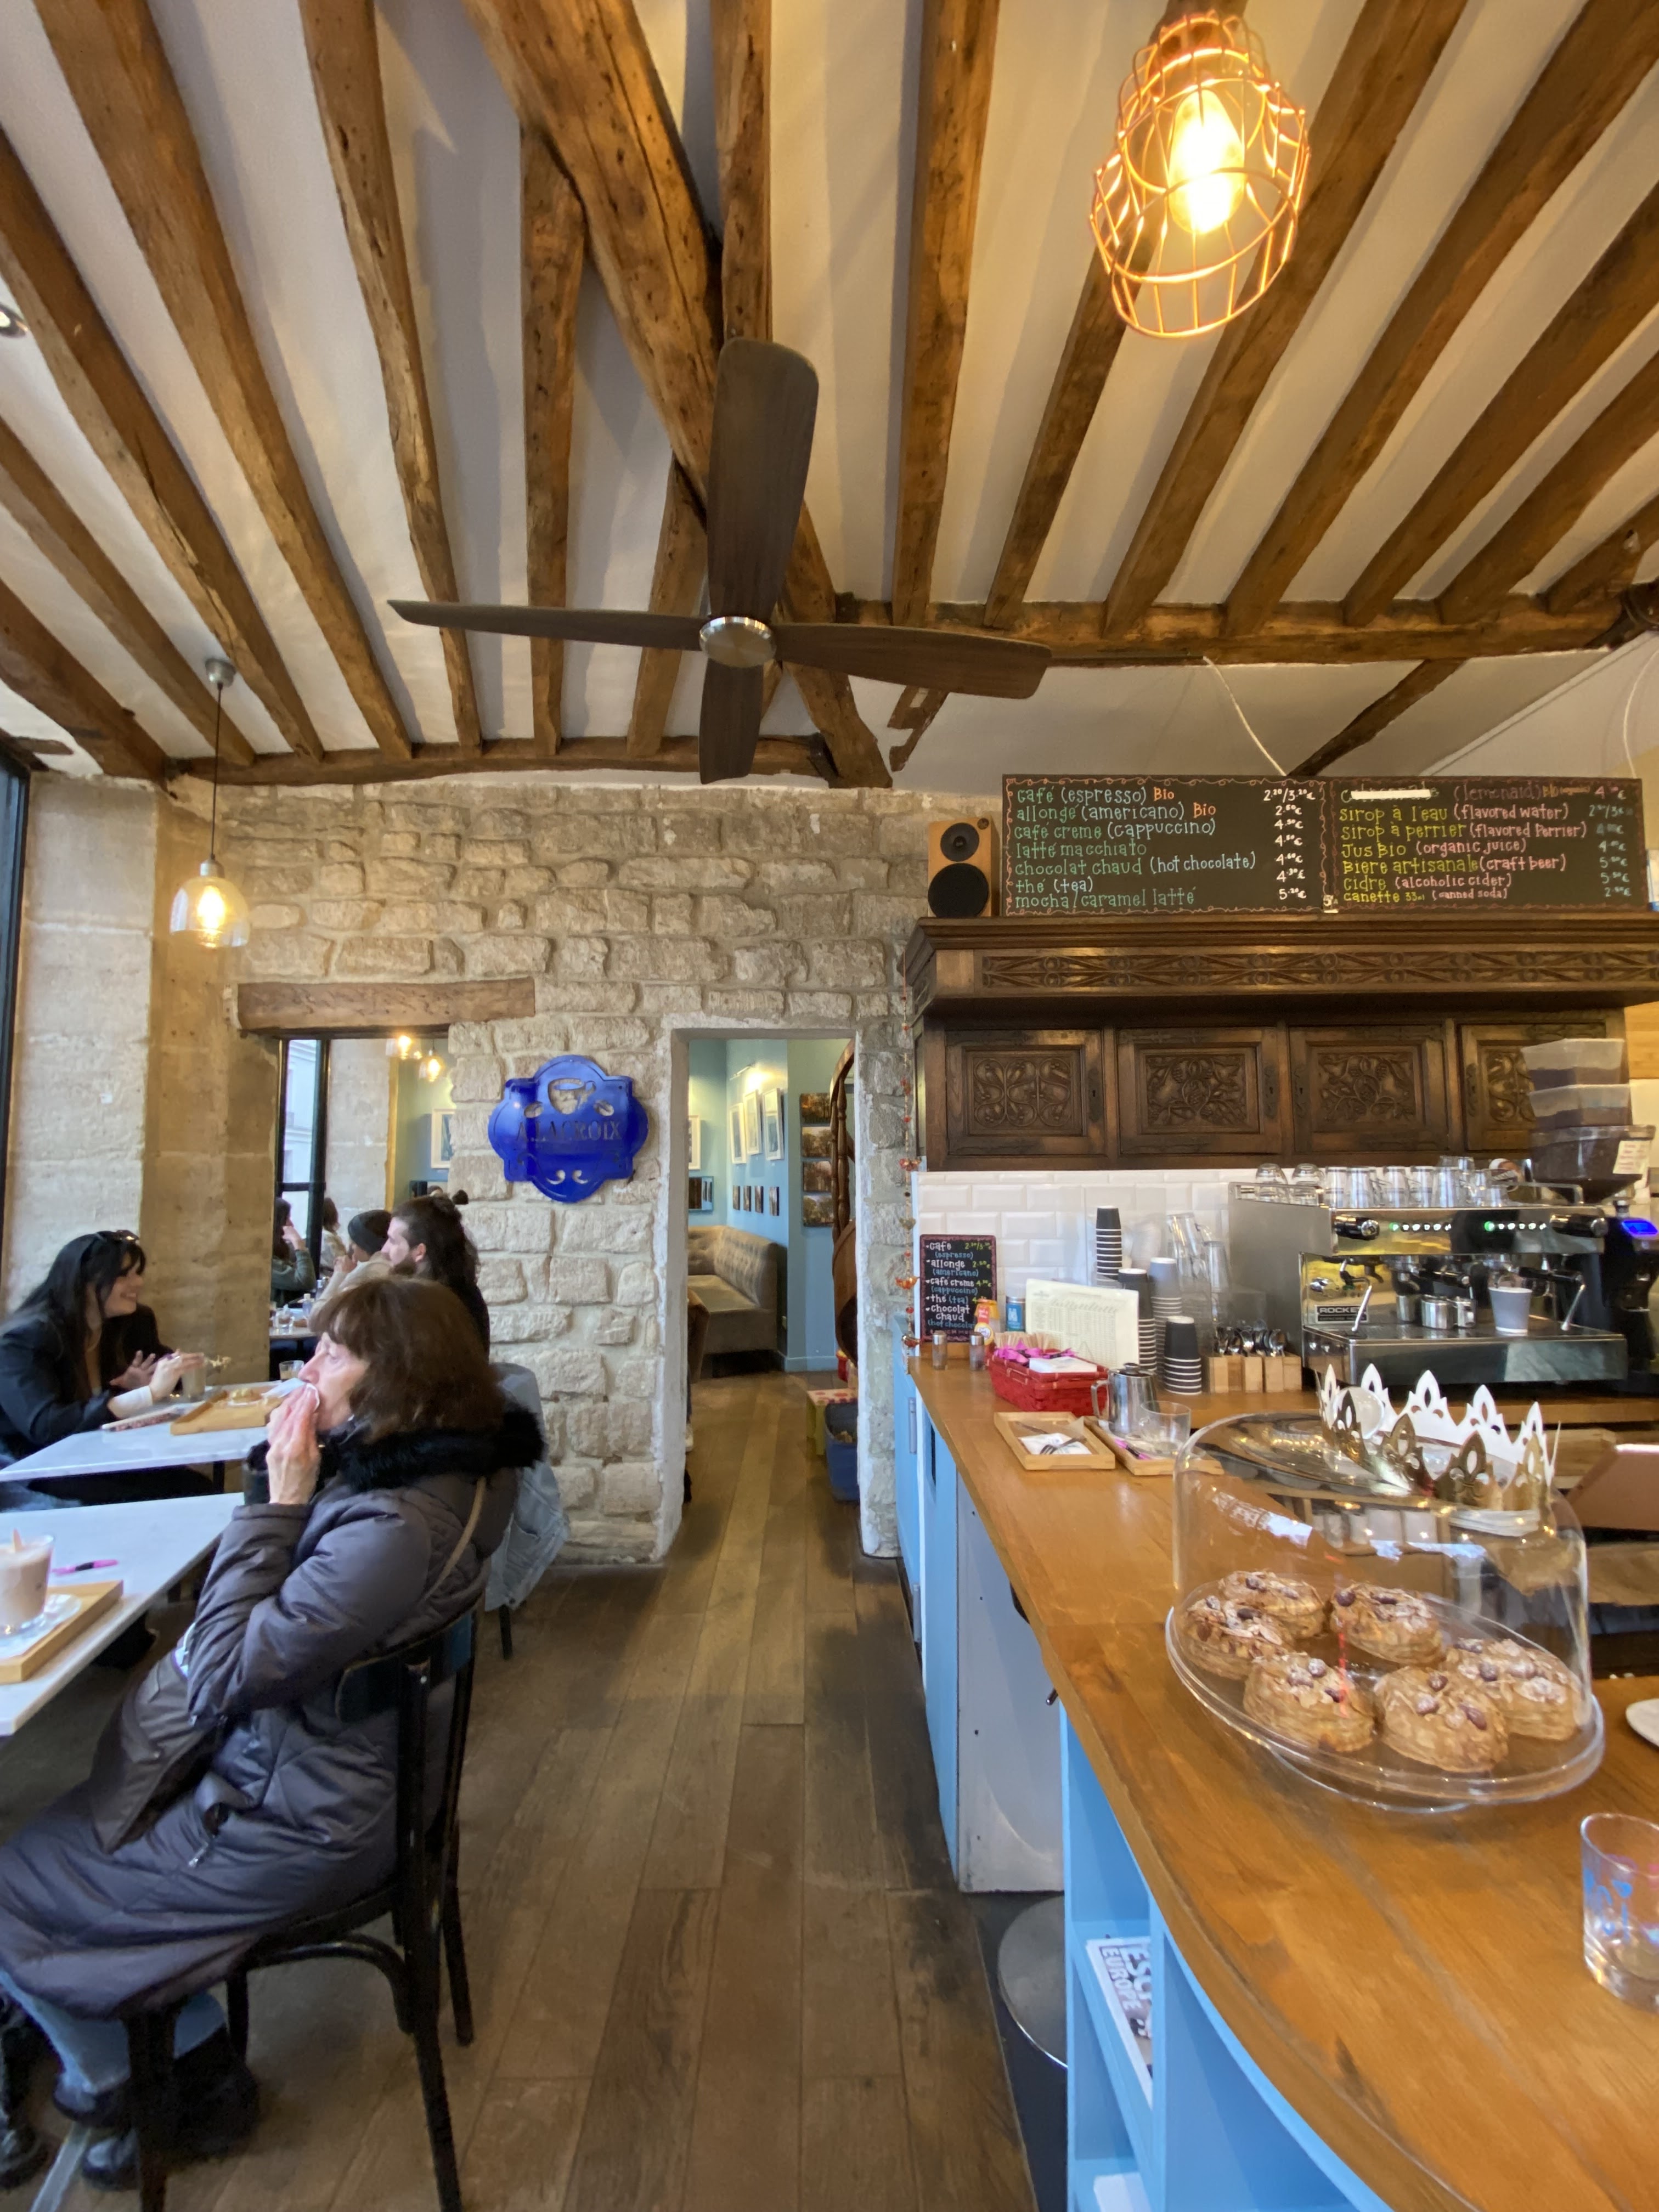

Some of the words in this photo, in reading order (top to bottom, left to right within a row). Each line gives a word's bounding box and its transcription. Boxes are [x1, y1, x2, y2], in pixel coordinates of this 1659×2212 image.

[1018, 786, 1054, 804] café
[1061, 786, 1146, 806] (espresso)
[1153, 786, 1175, 801] Bio
[1017, 804, 1079, 823] allongé
[1081, 801, 1184, 821] (americano)
[1193, 802, 1216, 818] Bio
[1339, 806, 1385, 825] sirop
[1454, 803, 1516, 820] (flavored
[1519, 802, 1569, 820] water)
[1015, 822, 1049, 840] café
[1054, 826, 1102, 839] creme
[1108, 817, 1215, 840] (cappuccino)
[1341, 825, 1385, 842] sirop
[1406, 823, 1466, 841] perrier
[1470, 822, 1530, 838] (flavored
[1536, 821, 1587, 838] Perrier)
[1060, 838, 1147, 856] macchiato
[1341, 843, 1373, 858] Jus
[1377, 842, 1406, 858] Bio
[1417, 841, 1481, 857] (organic
[1483, 838, 1526, 854] juice)
[1015, 859, 1086, 875] chocolat
[1092, 857, 1142, 874] chaud
[1150, 855, 1180, 874] (hot
[1183, 851, 1255, 871] chocolate)
[1393, 854, 1478, 874] artisanale
[1479, 856, 1526, 872] (craft
[1528, 853, 1566, 872] beer)
[1015, 878, 1046, 893] thé
[1054, 876, 1093, 893] (tea)
[1395, 874, 1465, 889] (alcoholic
[1468, 872, 1511, 887] cider)
[1344, 890, 1400, 903] canette
[935, 1251, 973, 1260] (espresso)
[933, 1268, 979, 1277] (americano)
[930, 1294, 947, 1303] thé
[949, 1295, 968, 1304] (tea)
[931, 1285, 978, 1295] (cappuccino)
